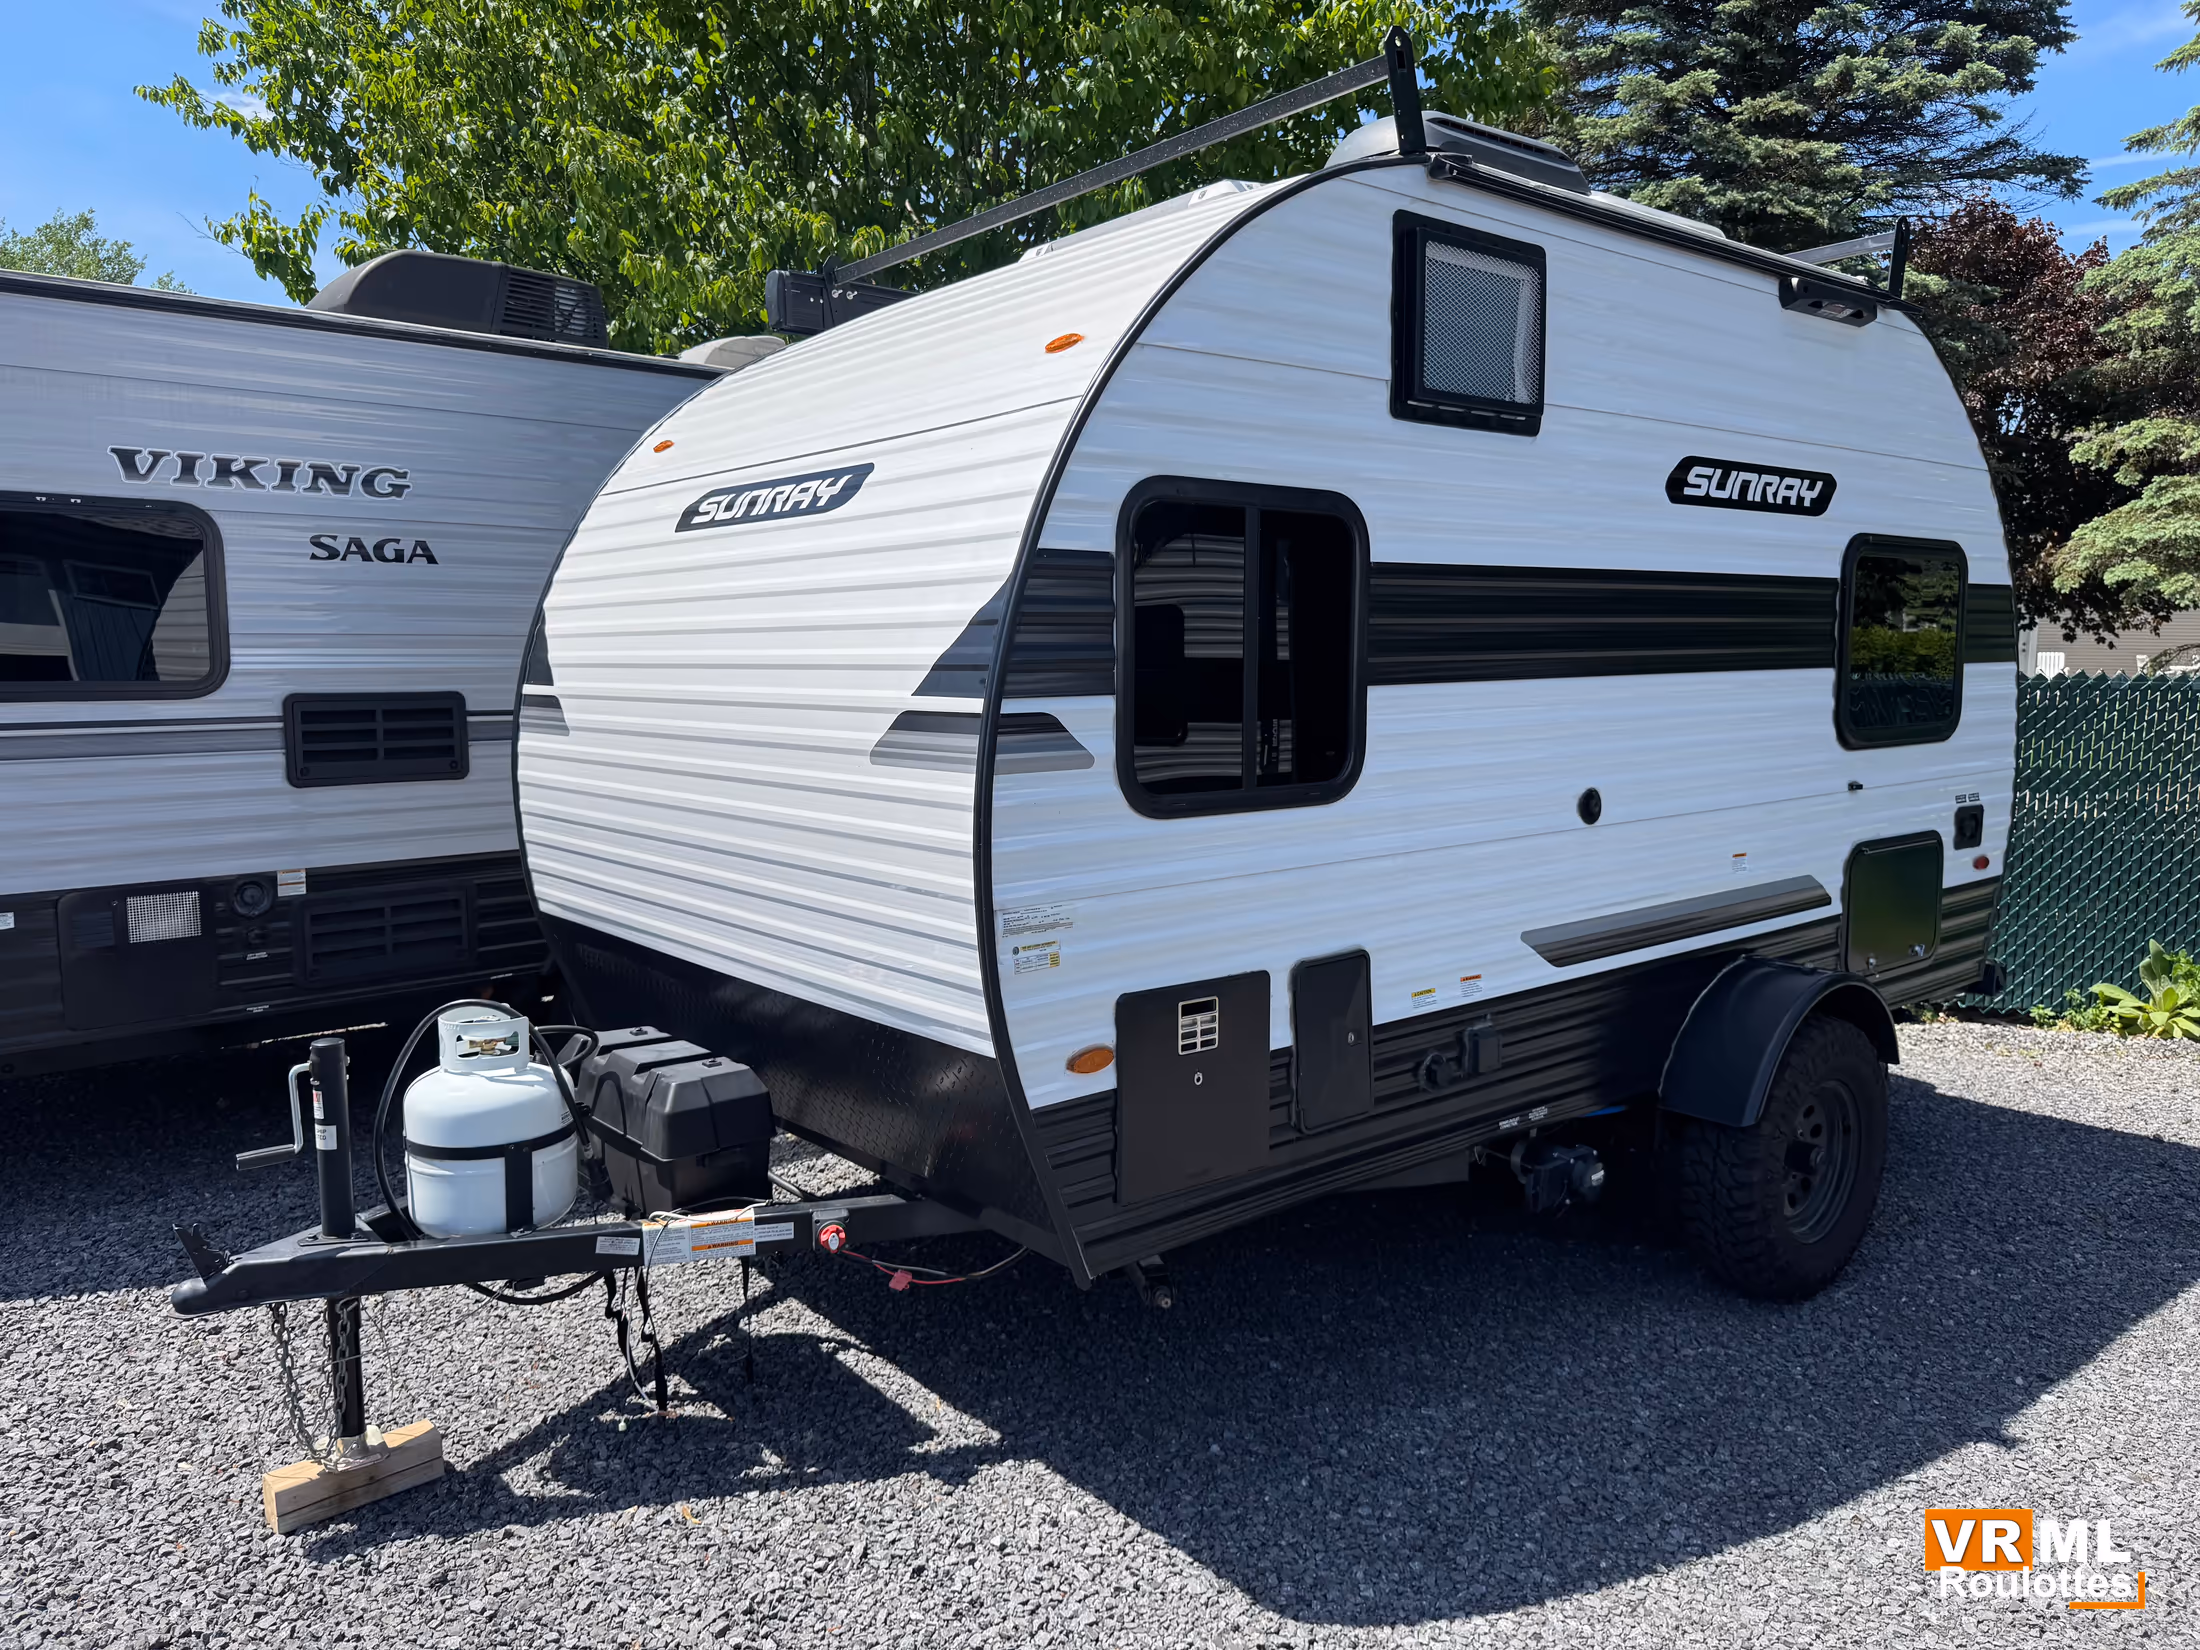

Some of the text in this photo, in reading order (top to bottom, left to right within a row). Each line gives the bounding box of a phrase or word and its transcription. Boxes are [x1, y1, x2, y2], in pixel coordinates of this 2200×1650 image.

[108, 446, 411, 499] VIKING
[1683, 466, 1823, 507] SUNRAY
[690, 474, 853, 524] SUNRAY
[310, 534, 438, 565] SAGA
[712, 1240, 739, 1248] WARNING
